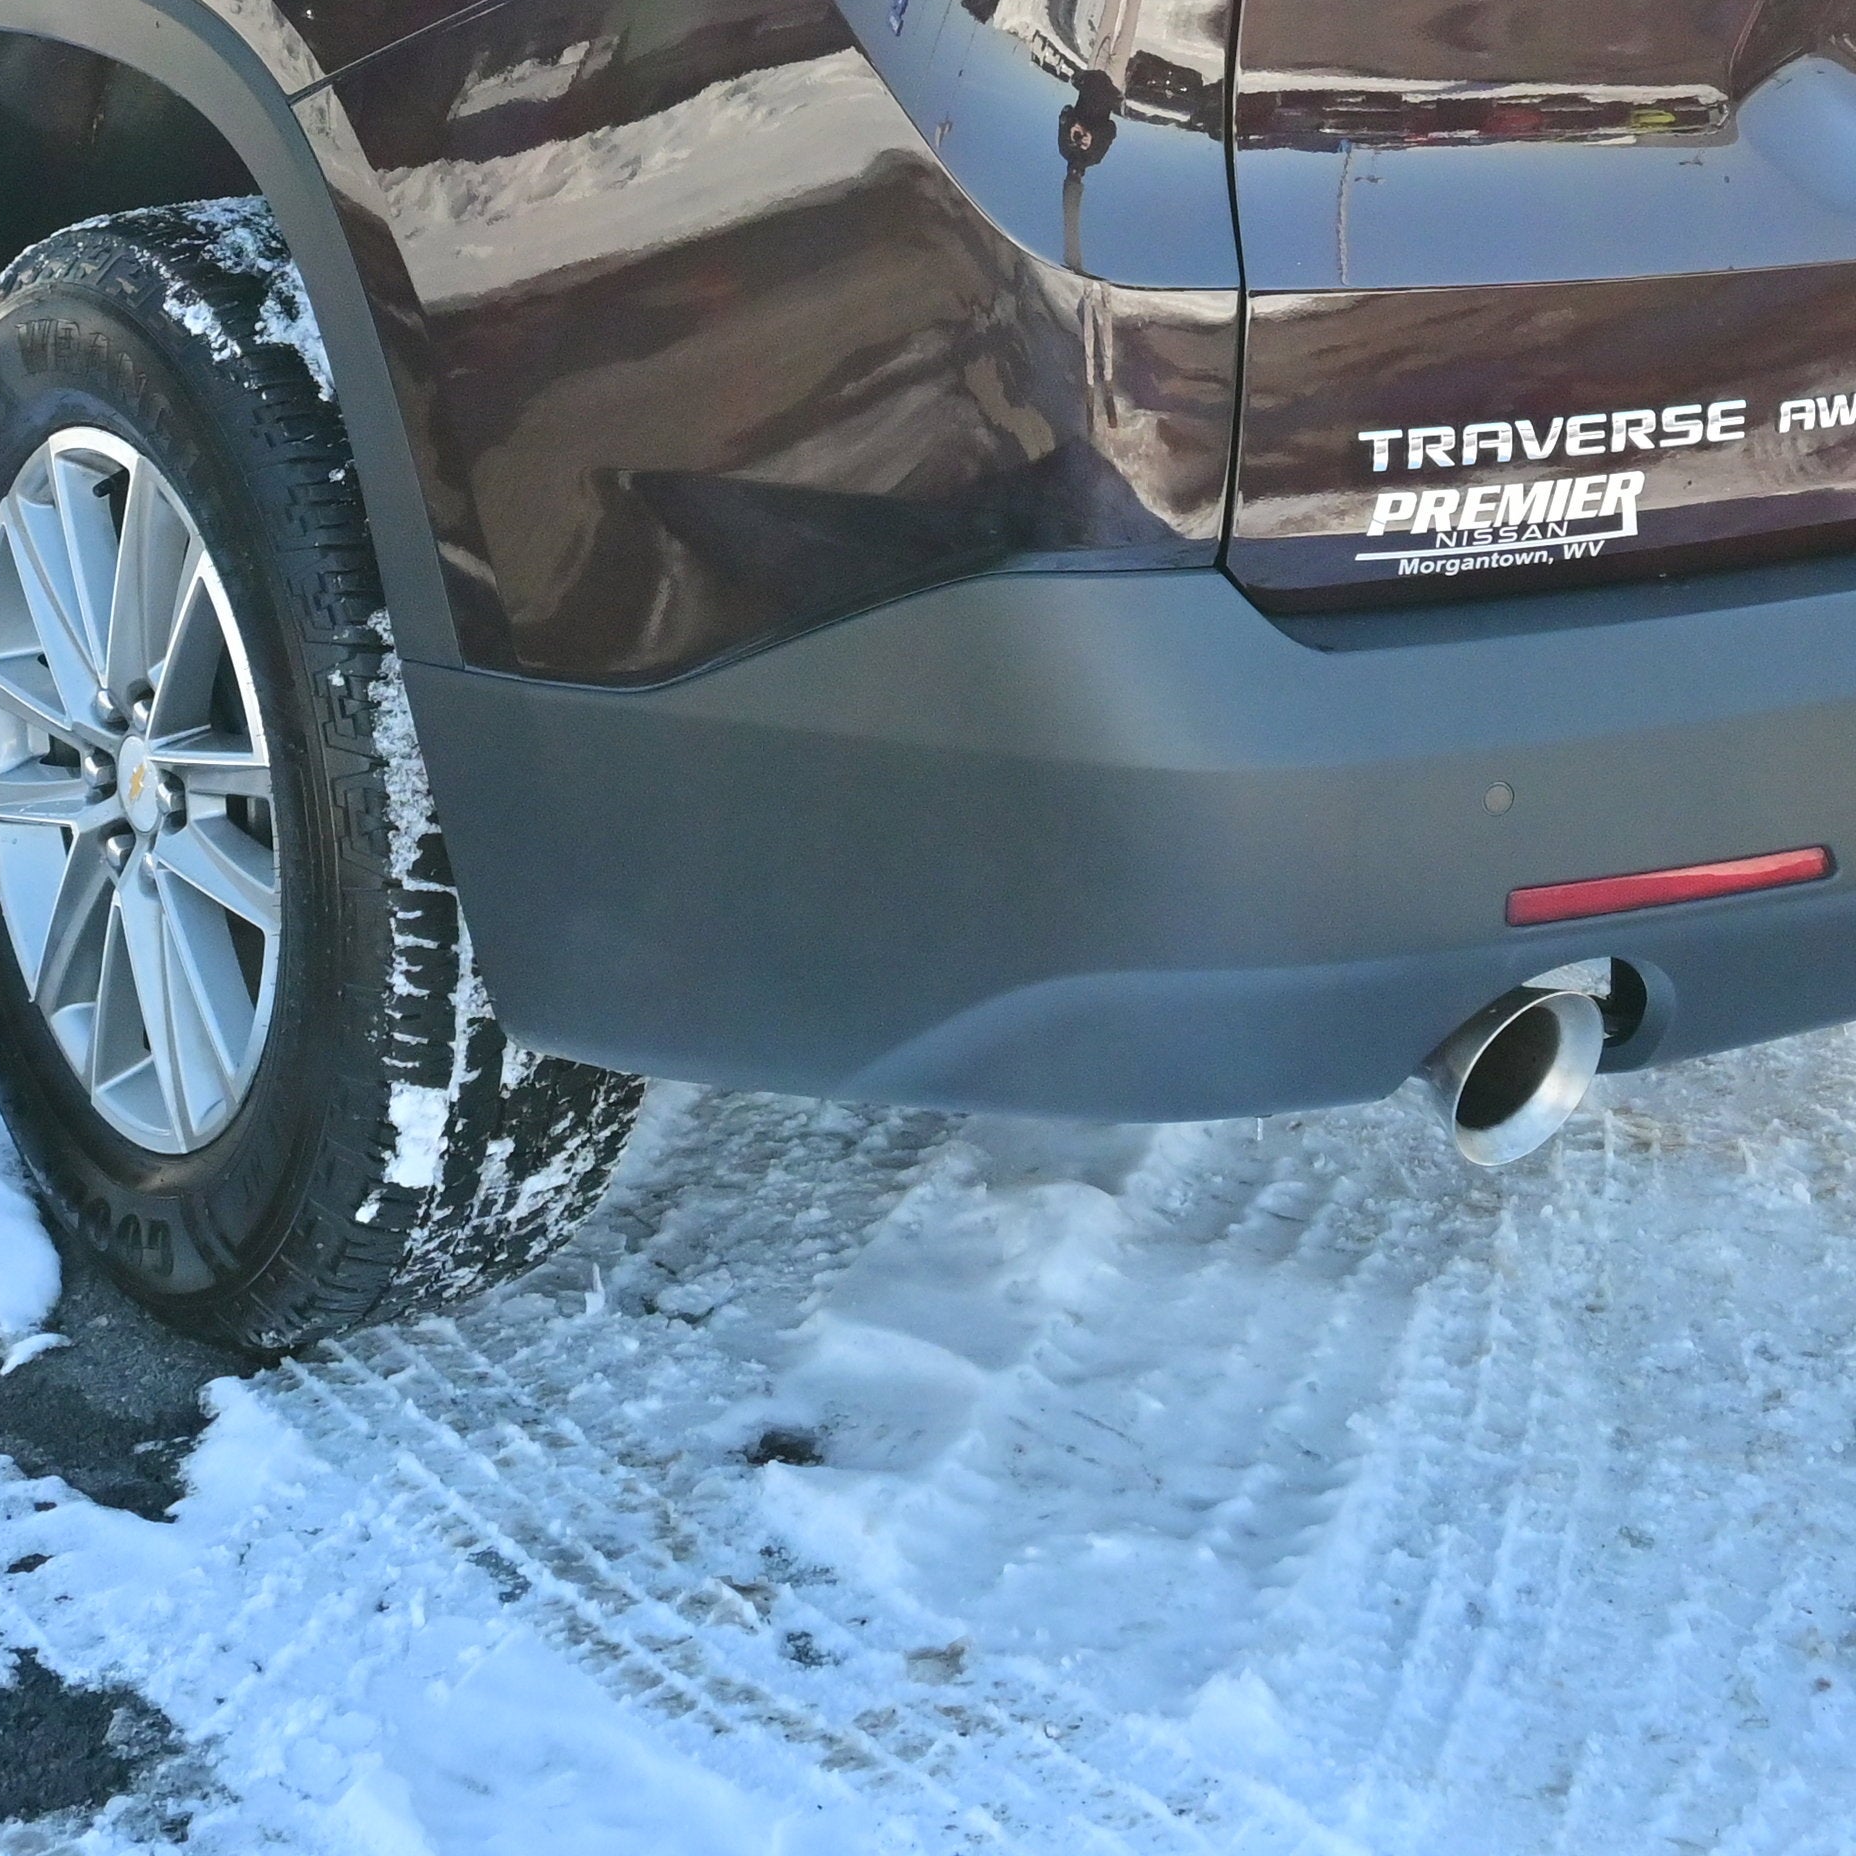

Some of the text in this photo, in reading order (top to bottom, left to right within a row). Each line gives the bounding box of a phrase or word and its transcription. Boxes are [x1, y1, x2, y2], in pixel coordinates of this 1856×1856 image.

[1358, 399, 1746, 472] TRAVERSE
[1366, 470, 1645, 536] PREMIER
[1398, 540, 1605, 576] Morgantown, WV
[1435, 521, 1568, 548] NISSAN
